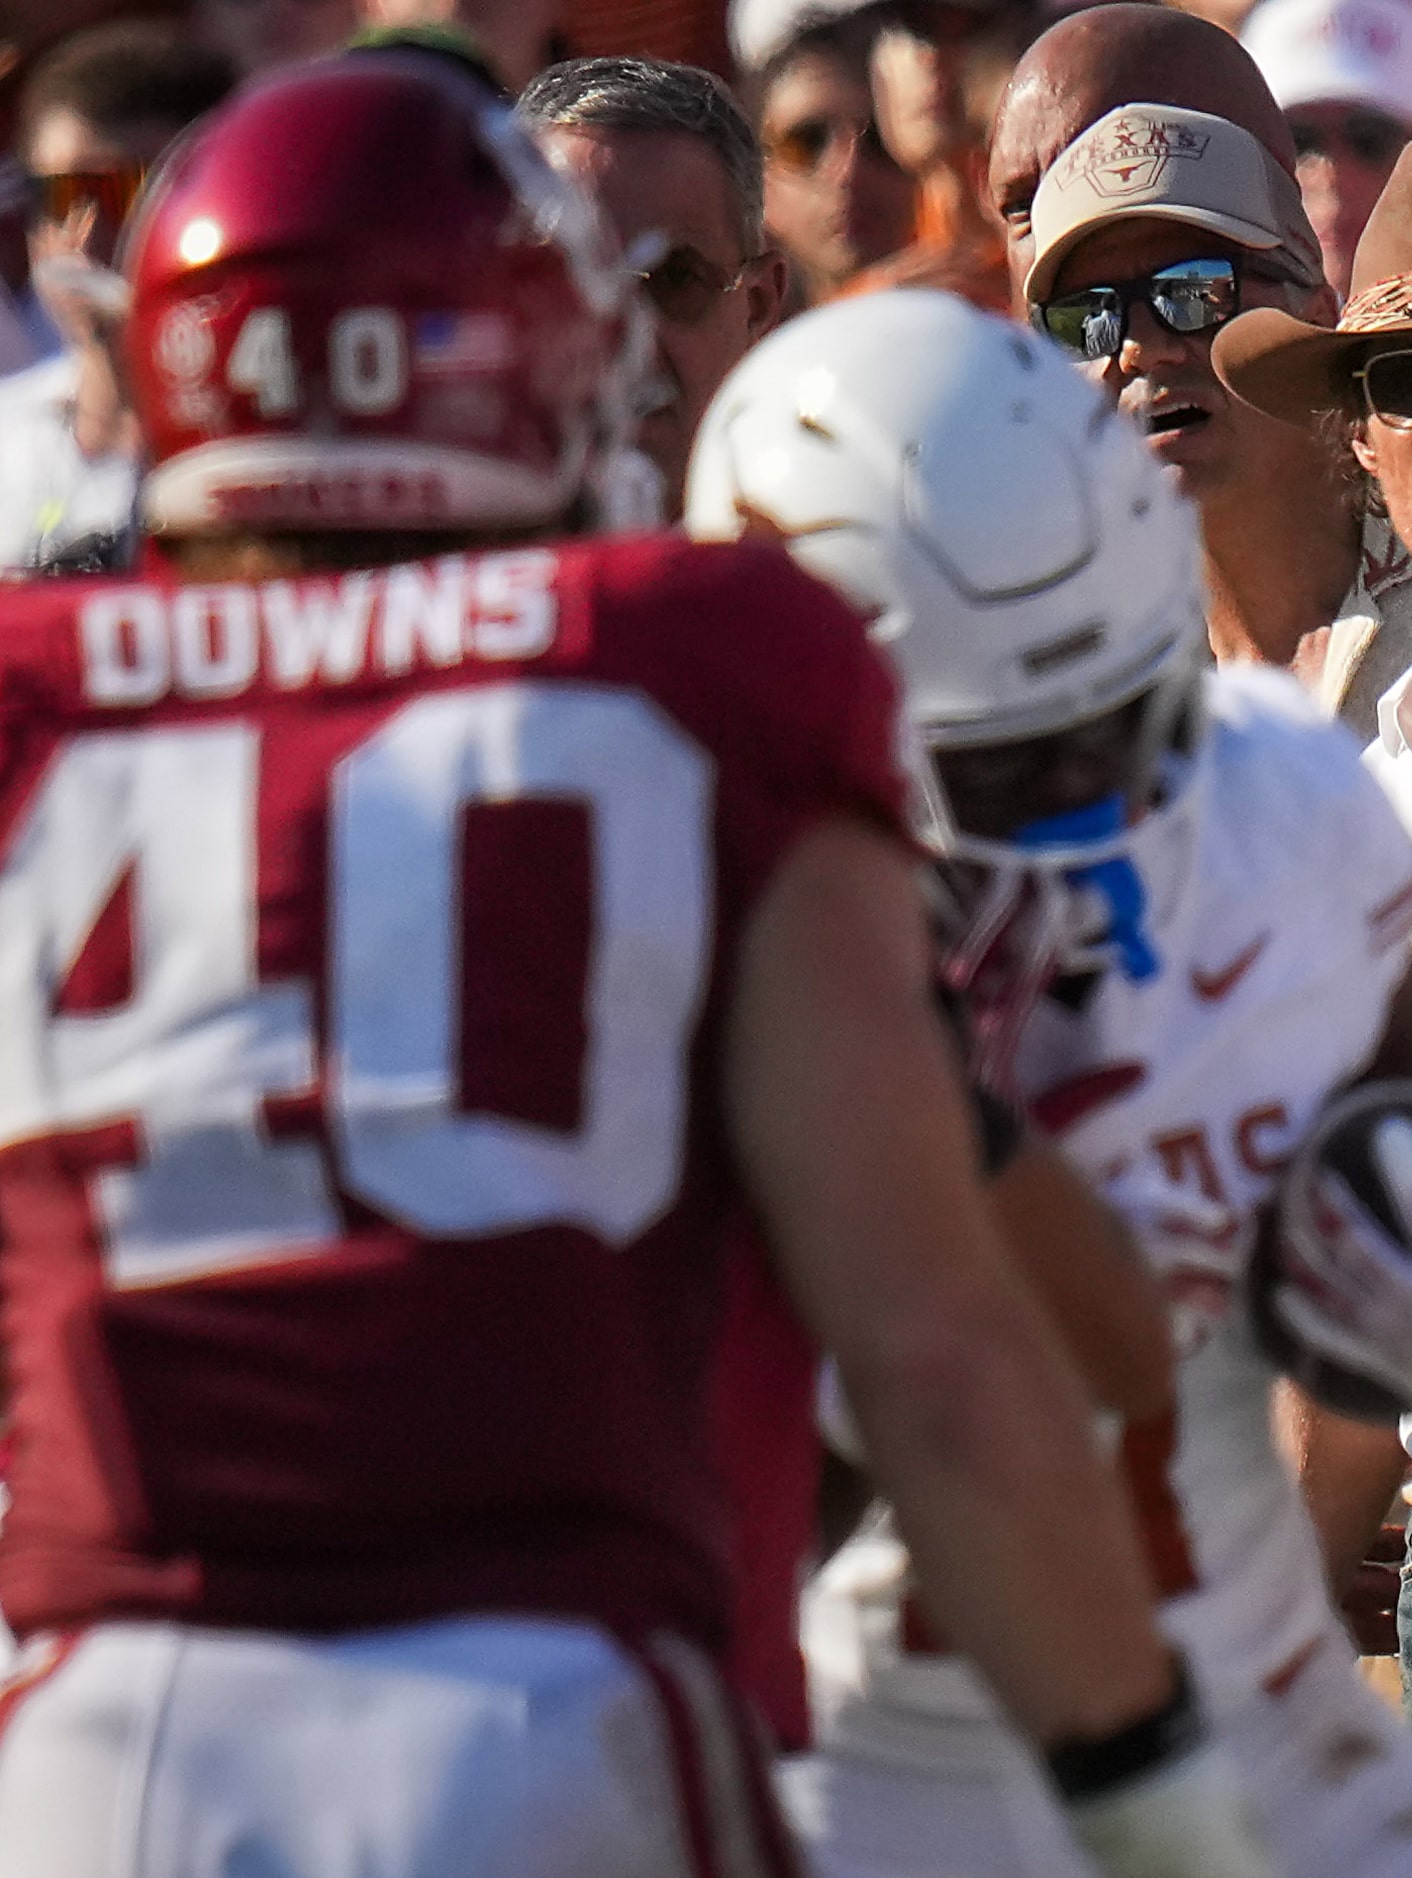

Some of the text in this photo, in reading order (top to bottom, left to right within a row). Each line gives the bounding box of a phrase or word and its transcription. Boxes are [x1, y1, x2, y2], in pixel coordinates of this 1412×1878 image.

[226, 305, 404, 420] 40
[80, 548, 559, 708] DOWNS
[0, 680, 715, 1292] 40
